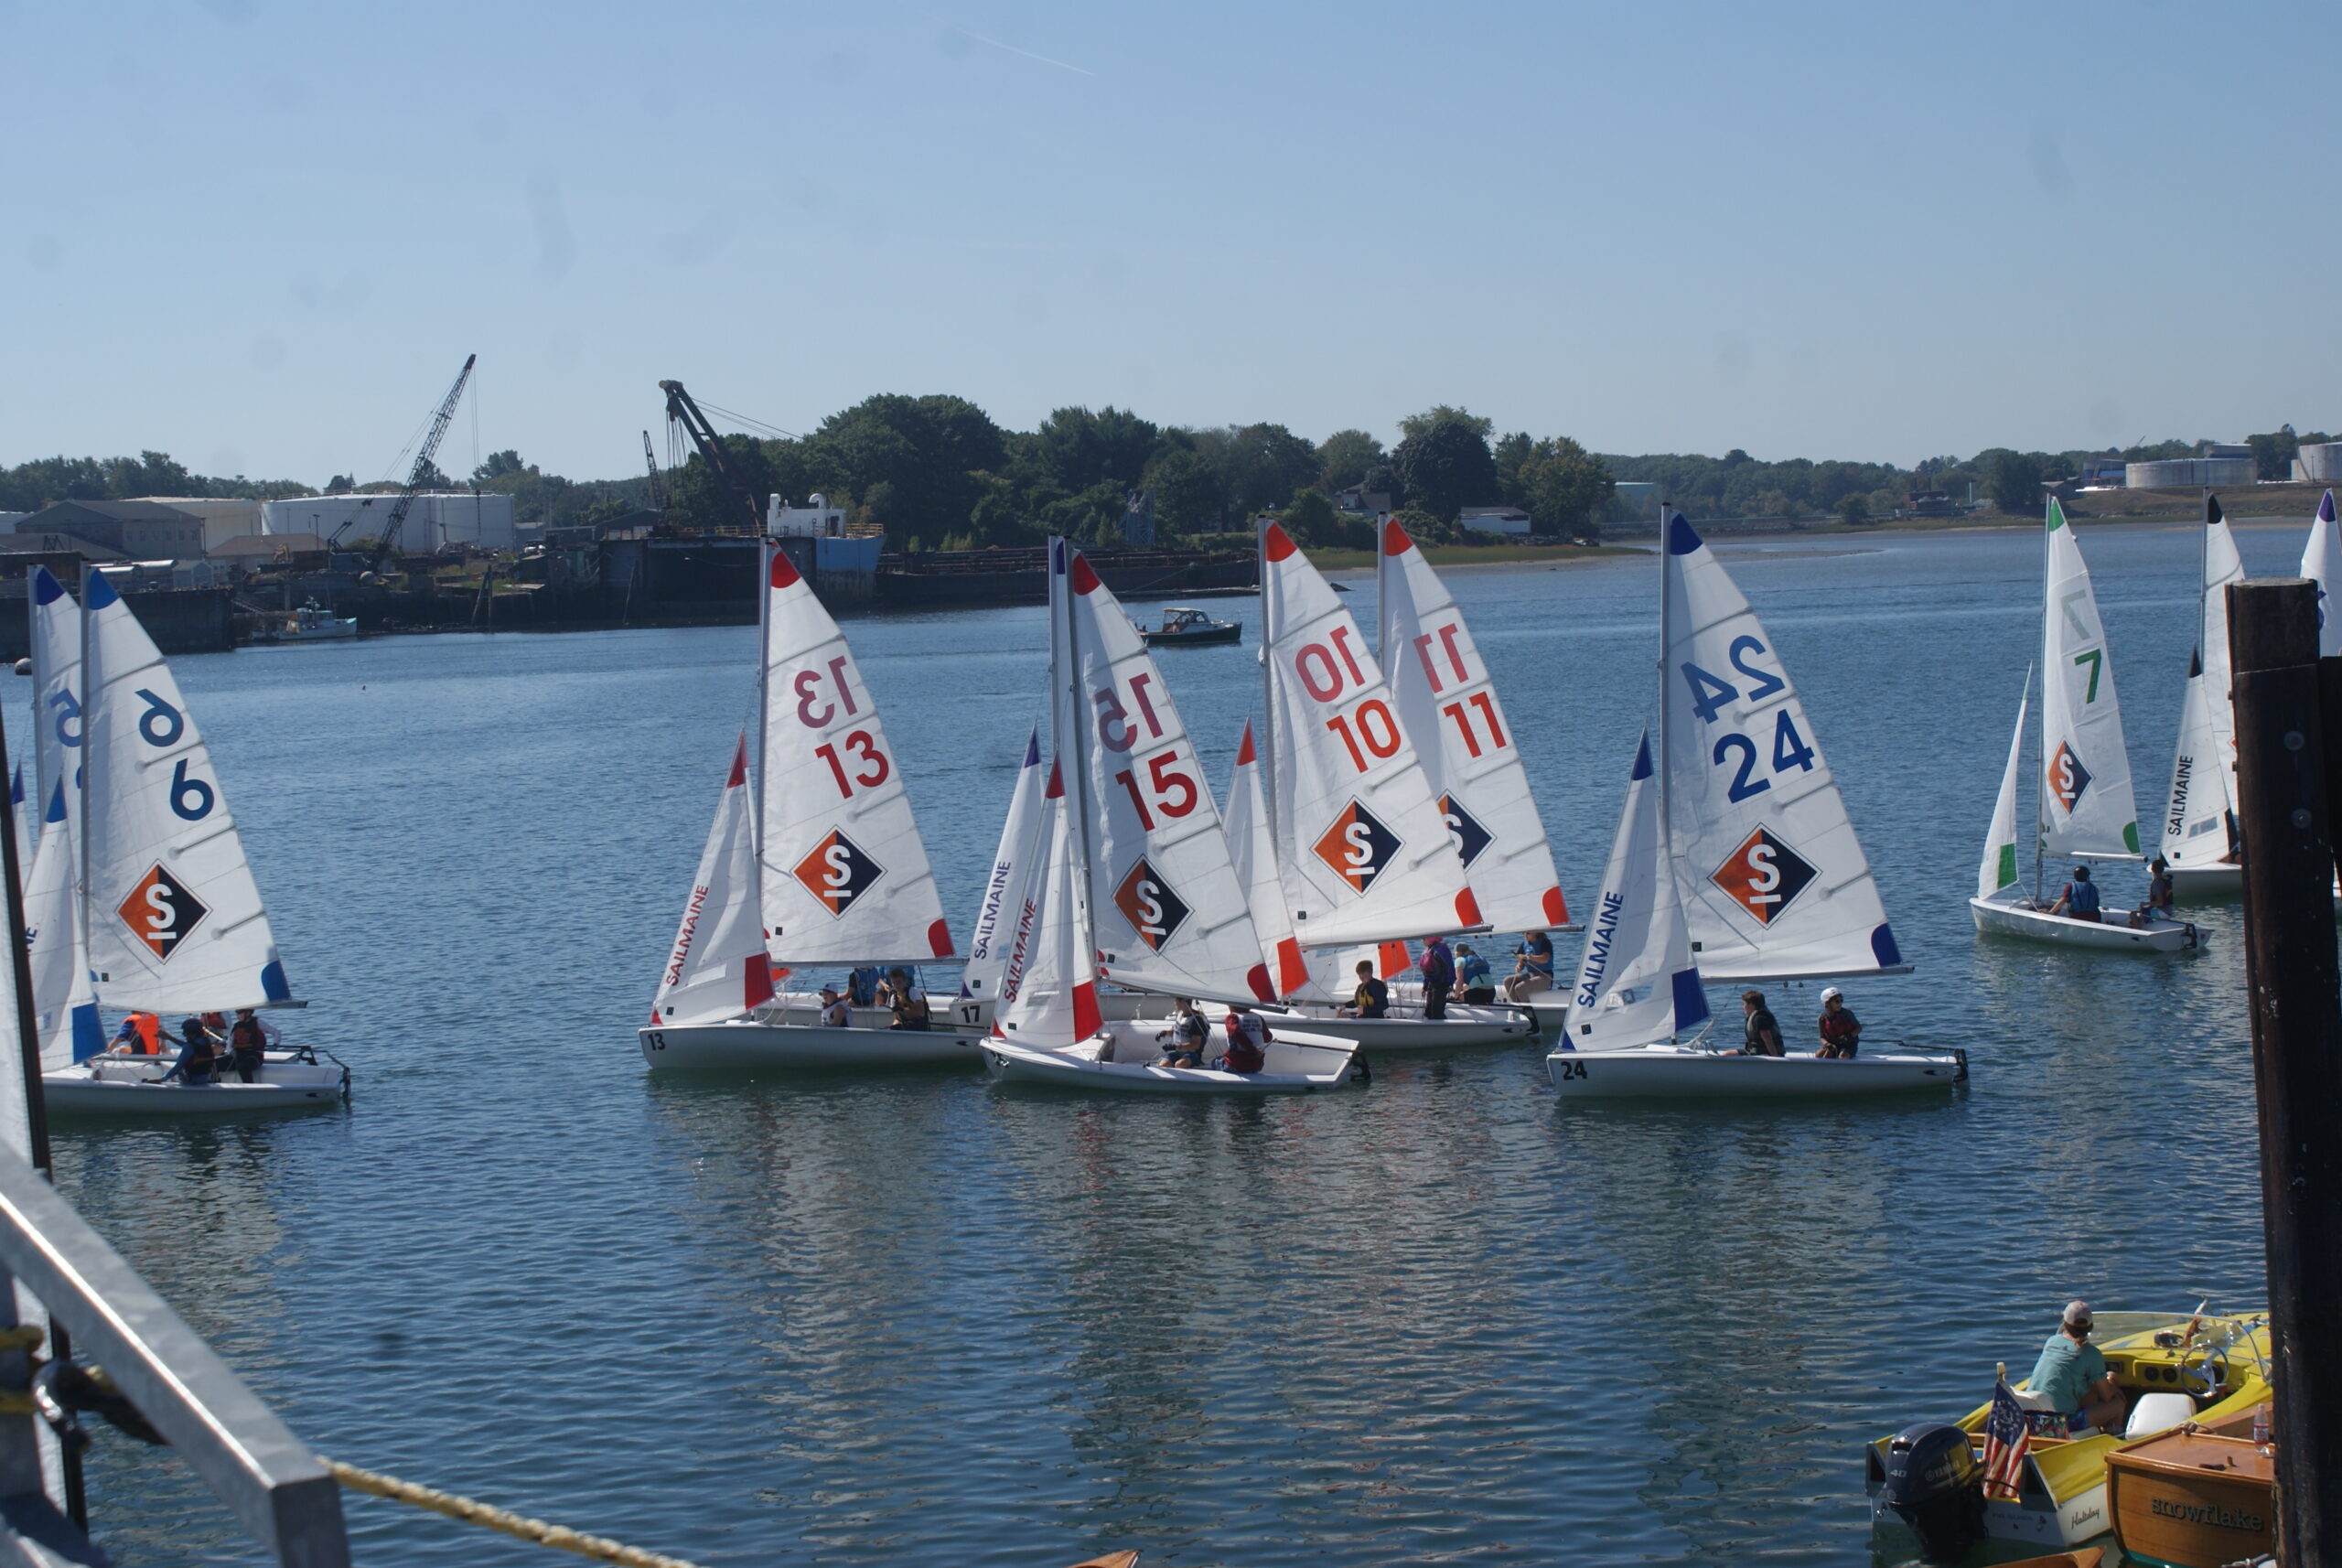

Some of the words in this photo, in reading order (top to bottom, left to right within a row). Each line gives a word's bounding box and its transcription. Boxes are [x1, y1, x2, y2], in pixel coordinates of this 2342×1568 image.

[2074, 649, 2101, 704] 7
[1327, 699, 1402, 774] 10
[1443, 692, 1507, 758] 11
[1713, 709, 1814, 804] 24
[169, 758, 214, 821] 6
[815, 730, 889, 800] 13
[1115, 751, 1198, 832] 15
[2168, 755, 2193, 836] SAILMAINE
[666, 884, 709, 986] SAILMAINE
[974, 860, 1011, 961] SAILMAINE
[1004, 897, 1037, 1004] SAILMAINE
[1578, 891, 1624, 1008] SAILMAINE
[648, 1033, 666, 1052] 13
[961, 1004, 980, 1023] 17
[1562, 1061, 1587, 1080] 24
[2152, 1498, 2263, 1532] snowflake
